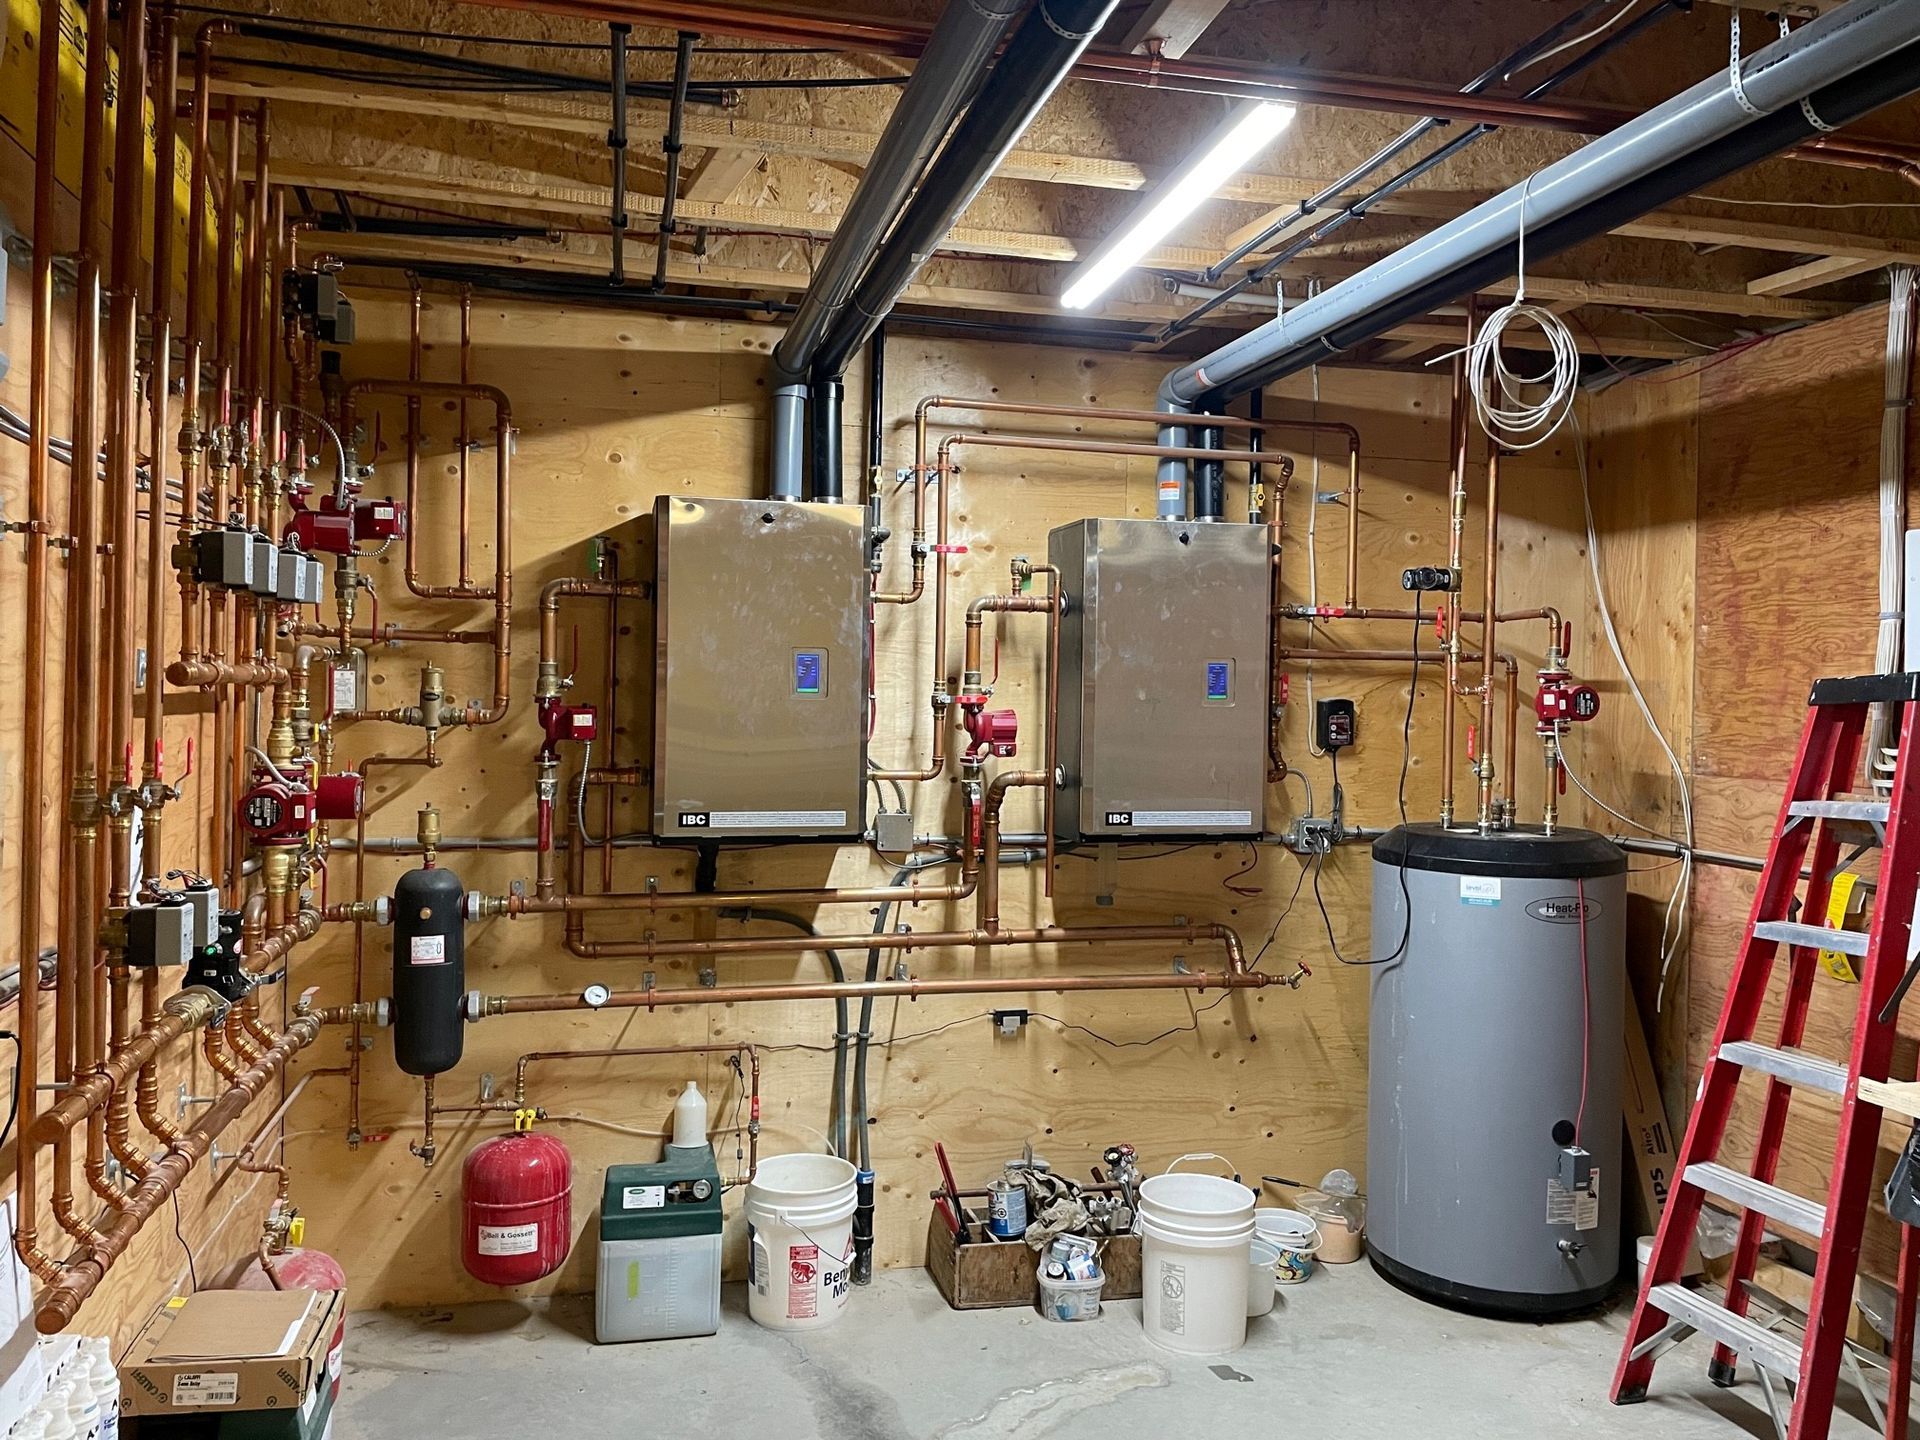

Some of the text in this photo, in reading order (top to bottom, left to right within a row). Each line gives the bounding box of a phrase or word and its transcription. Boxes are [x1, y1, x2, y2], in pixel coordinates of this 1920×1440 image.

[682, 814, 706, 825] IBC
[1108, 813, 1129, 824] IBC
[1546, 902, 1589, 913] Heat-Fo
[131, 1368, 160, 1397] CALEFFI
